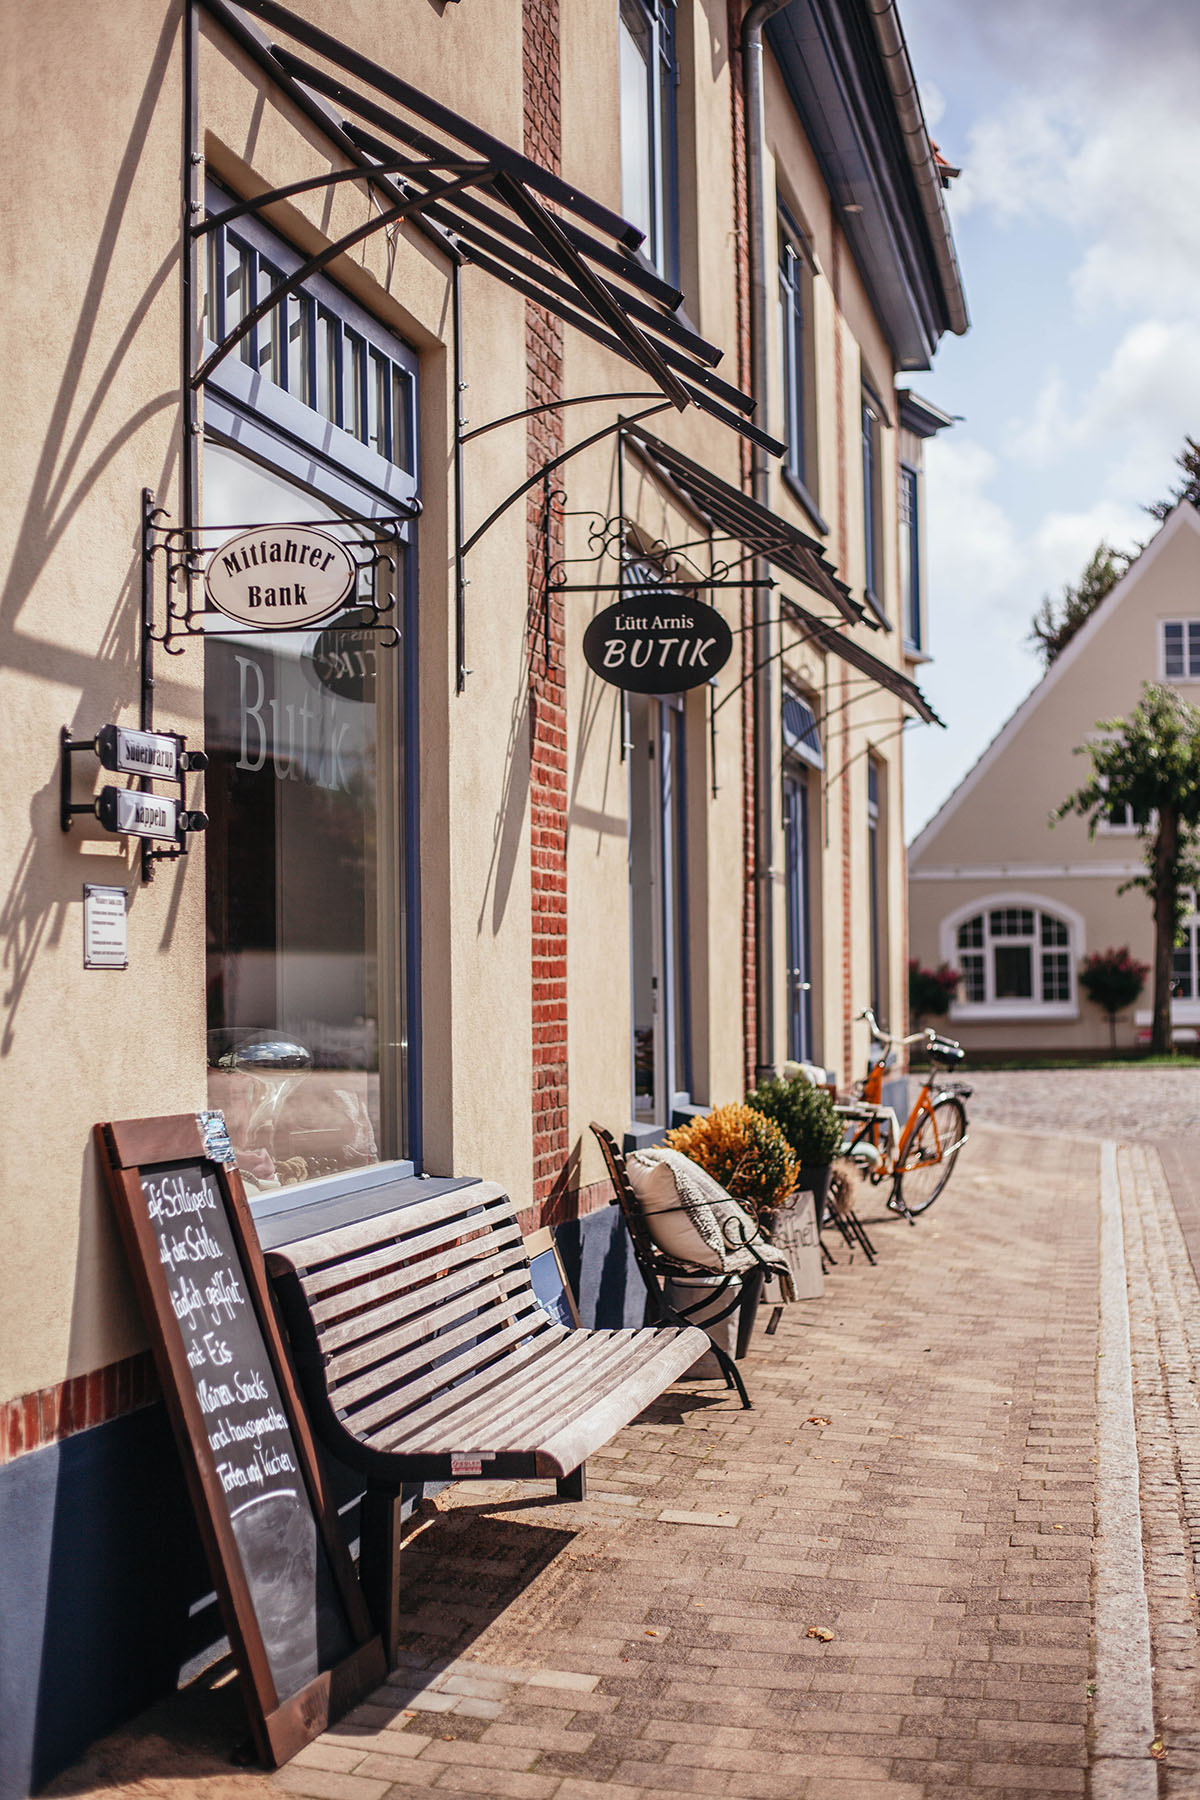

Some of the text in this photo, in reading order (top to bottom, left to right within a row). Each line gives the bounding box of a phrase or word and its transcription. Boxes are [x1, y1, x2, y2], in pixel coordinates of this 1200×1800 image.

[221, 539, 336, 578] Mitfahrer
[248, 584, 308, 608] Bank
[615, 614, 694, 631] Lütt Arnis
[602, 637, 717, 668] BUTIK
[135, 802, 167, 829] Kappeln
[187, 1331, 233, 1369] mit Eis
[208, 1418, 231, 1451] und
[258, 1446, 296, 1477] Kuchen
